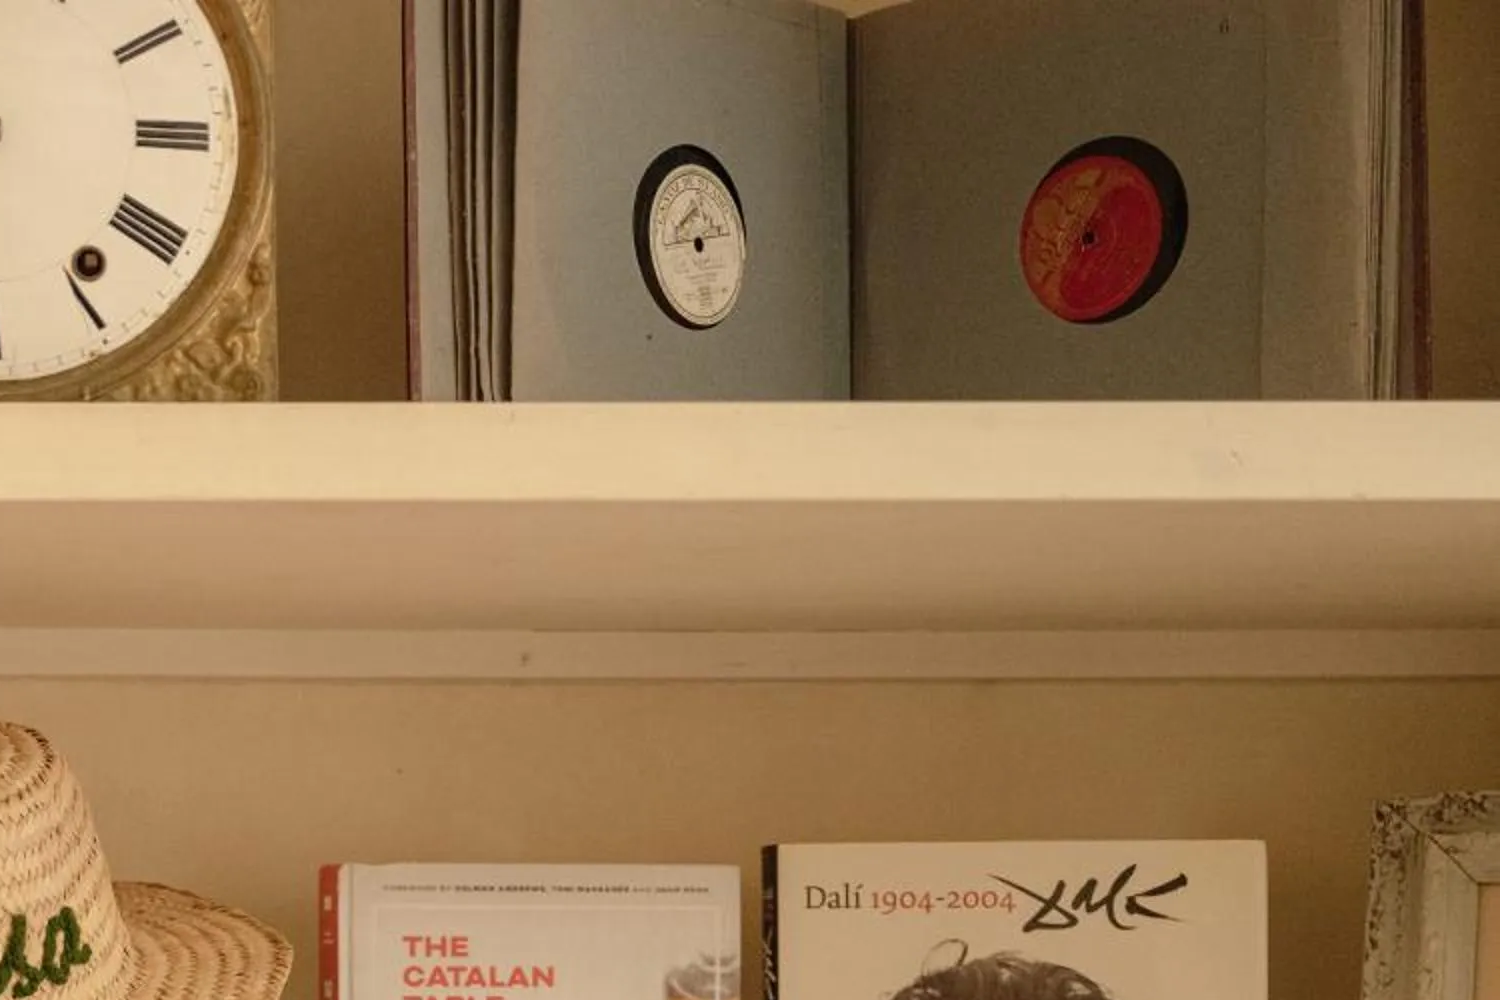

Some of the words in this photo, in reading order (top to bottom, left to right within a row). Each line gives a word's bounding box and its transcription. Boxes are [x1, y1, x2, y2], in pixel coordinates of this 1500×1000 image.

[805, 882, 862, 910] Dalí
[871, 889, 1018, 914] 1904-2004
[402, 936, 469, 957] THE
[403, 965, 555, 988] CATALAN
